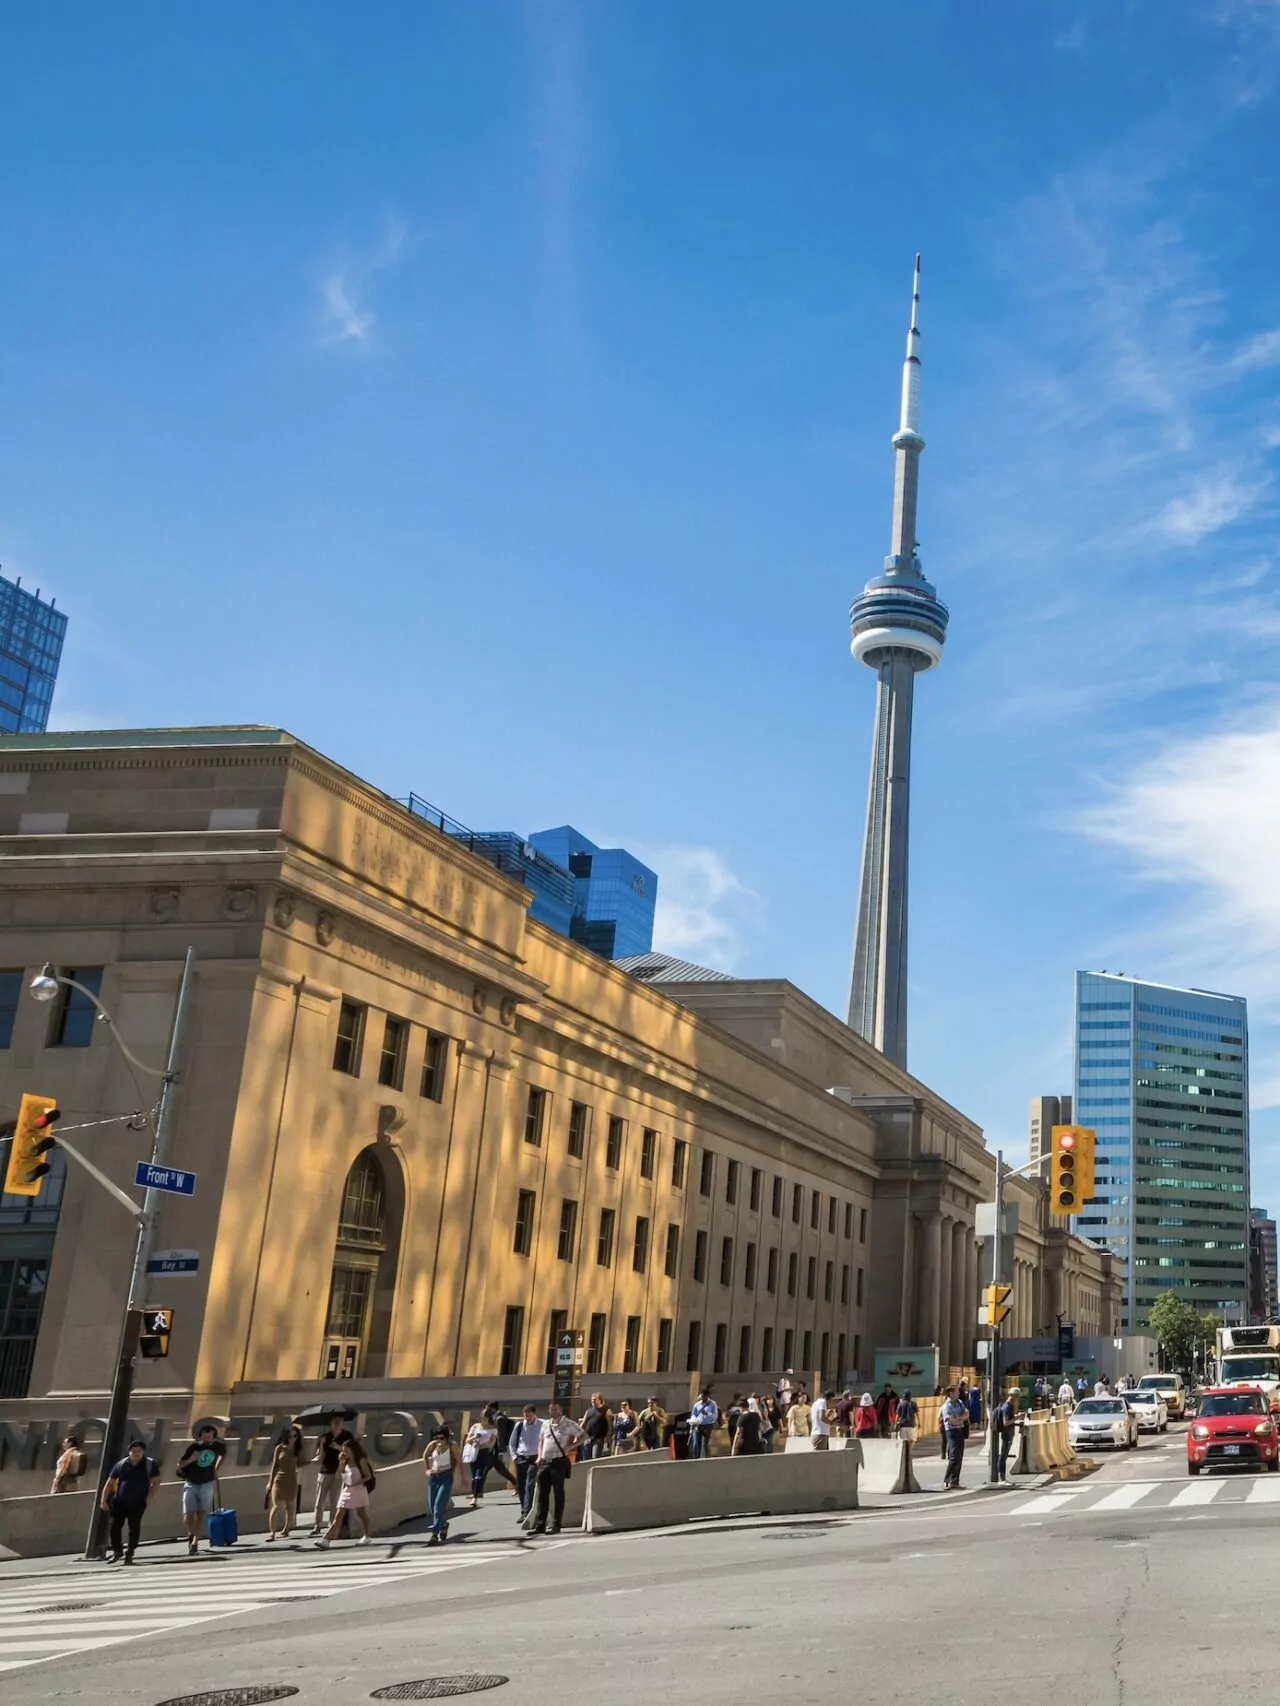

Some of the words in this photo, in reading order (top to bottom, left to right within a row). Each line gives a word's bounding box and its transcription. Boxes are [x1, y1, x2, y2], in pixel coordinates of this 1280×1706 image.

[342, 931, 392, 970] POSTAL
[146, 1167, 169, 1185] Front
[176, 1173, 185, 1188] W
[161, 1261, 176, 1271] Bay
[0, 1418, 170, 1471] NION
